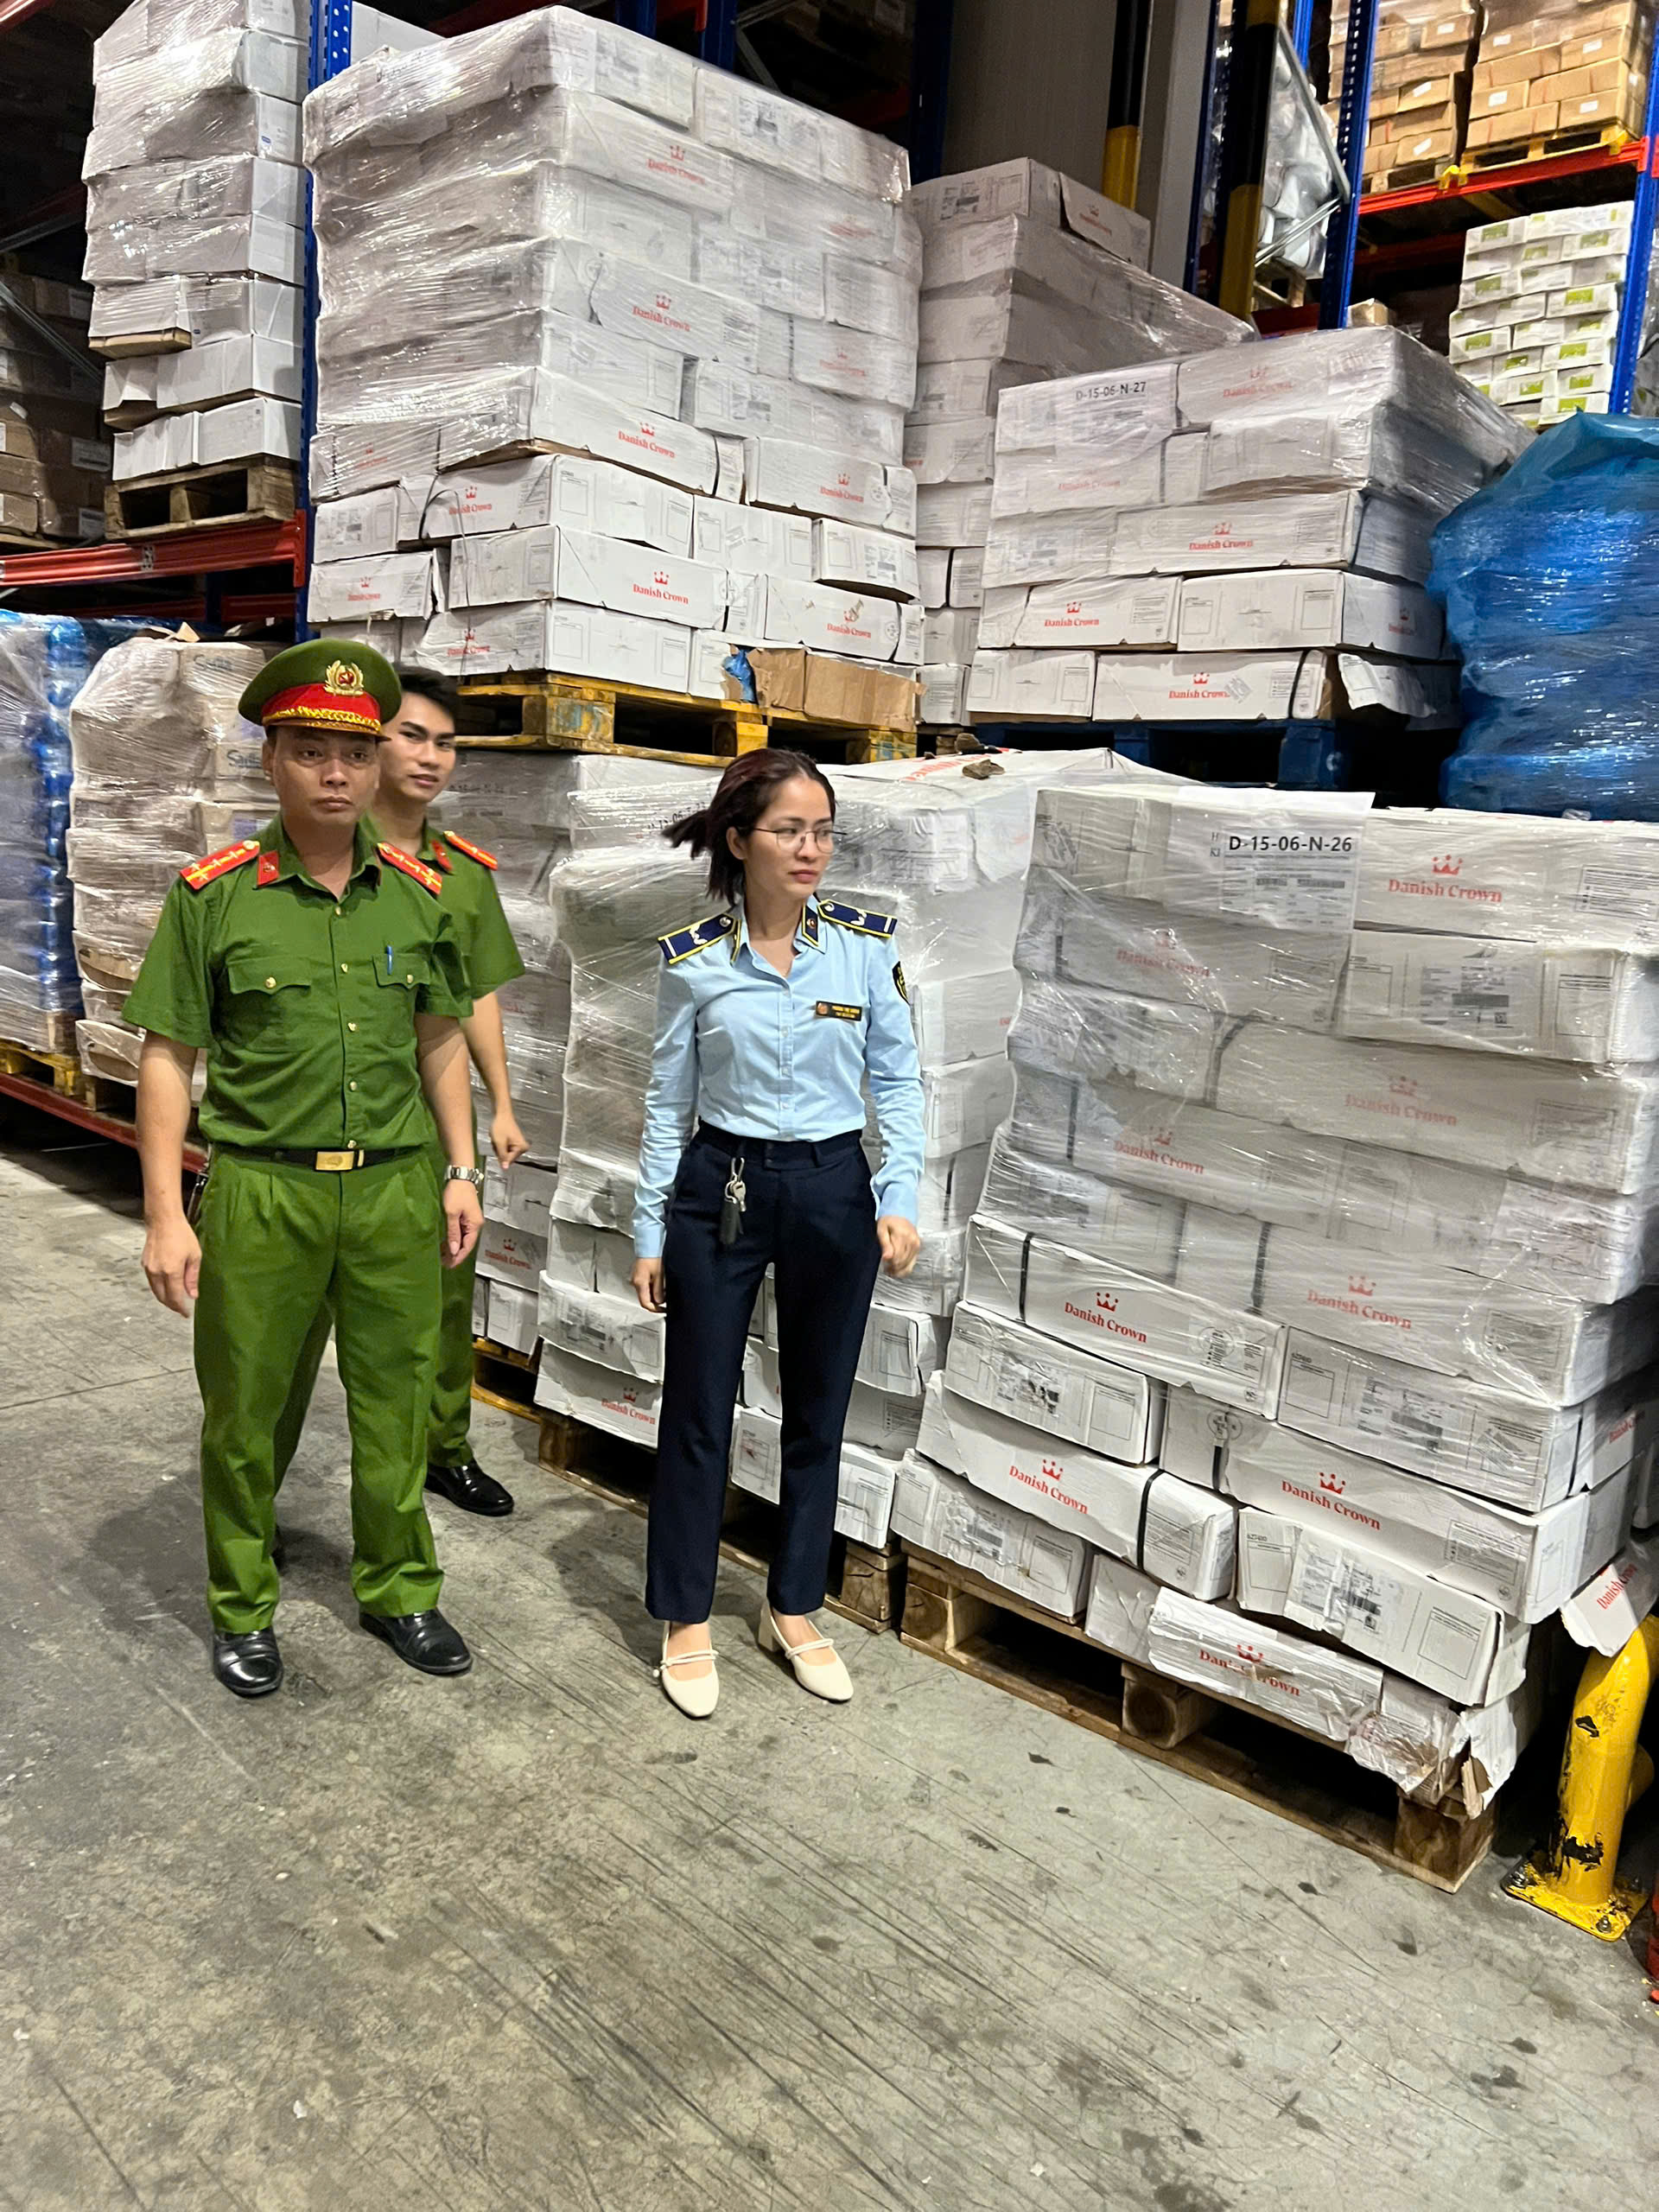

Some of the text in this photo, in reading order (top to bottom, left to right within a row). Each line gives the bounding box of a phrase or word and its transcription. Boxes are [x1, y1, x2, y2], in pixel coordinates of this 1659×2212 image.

[632, 306, 690, 332] Danish Crown
[1076, 382, 1146, 400] D-15-06-N-27
[619, 431, 676, 458] Danish Crown
[820, 486, 842, 499] Danish
[1189, 539, 1253, 550] Danish Crown
[633, 584, 689, 604] Danish Crown
[827, 623, 871, 638] Danish Crown
[1169, 690, 1199, 699] Danish
[1230, 836, 1352, 851] D-15-06-N-26
[1388, 878, 1503, 902] Danish Crown
[1344, 1094, 1458, 1126] Danish Crown
[1115, 1140, 1204, 1173] Danish Crown
[485, 1249, 512, 1264] Danish
[1306, 1288, 1411, 1329] Danish Crown
[1065, 1301, 1147, 1343] Danish Crown
[601, 1397, 655, 1425] Danish Crown
[1009, 1465, 1088, 1514] Danish Crown
[1281, 1480, 1380, 1530] Danish Crown
[1597, 1580, 1624, 1610] Danish
[1255, 1672, 1300, 1696] rown
